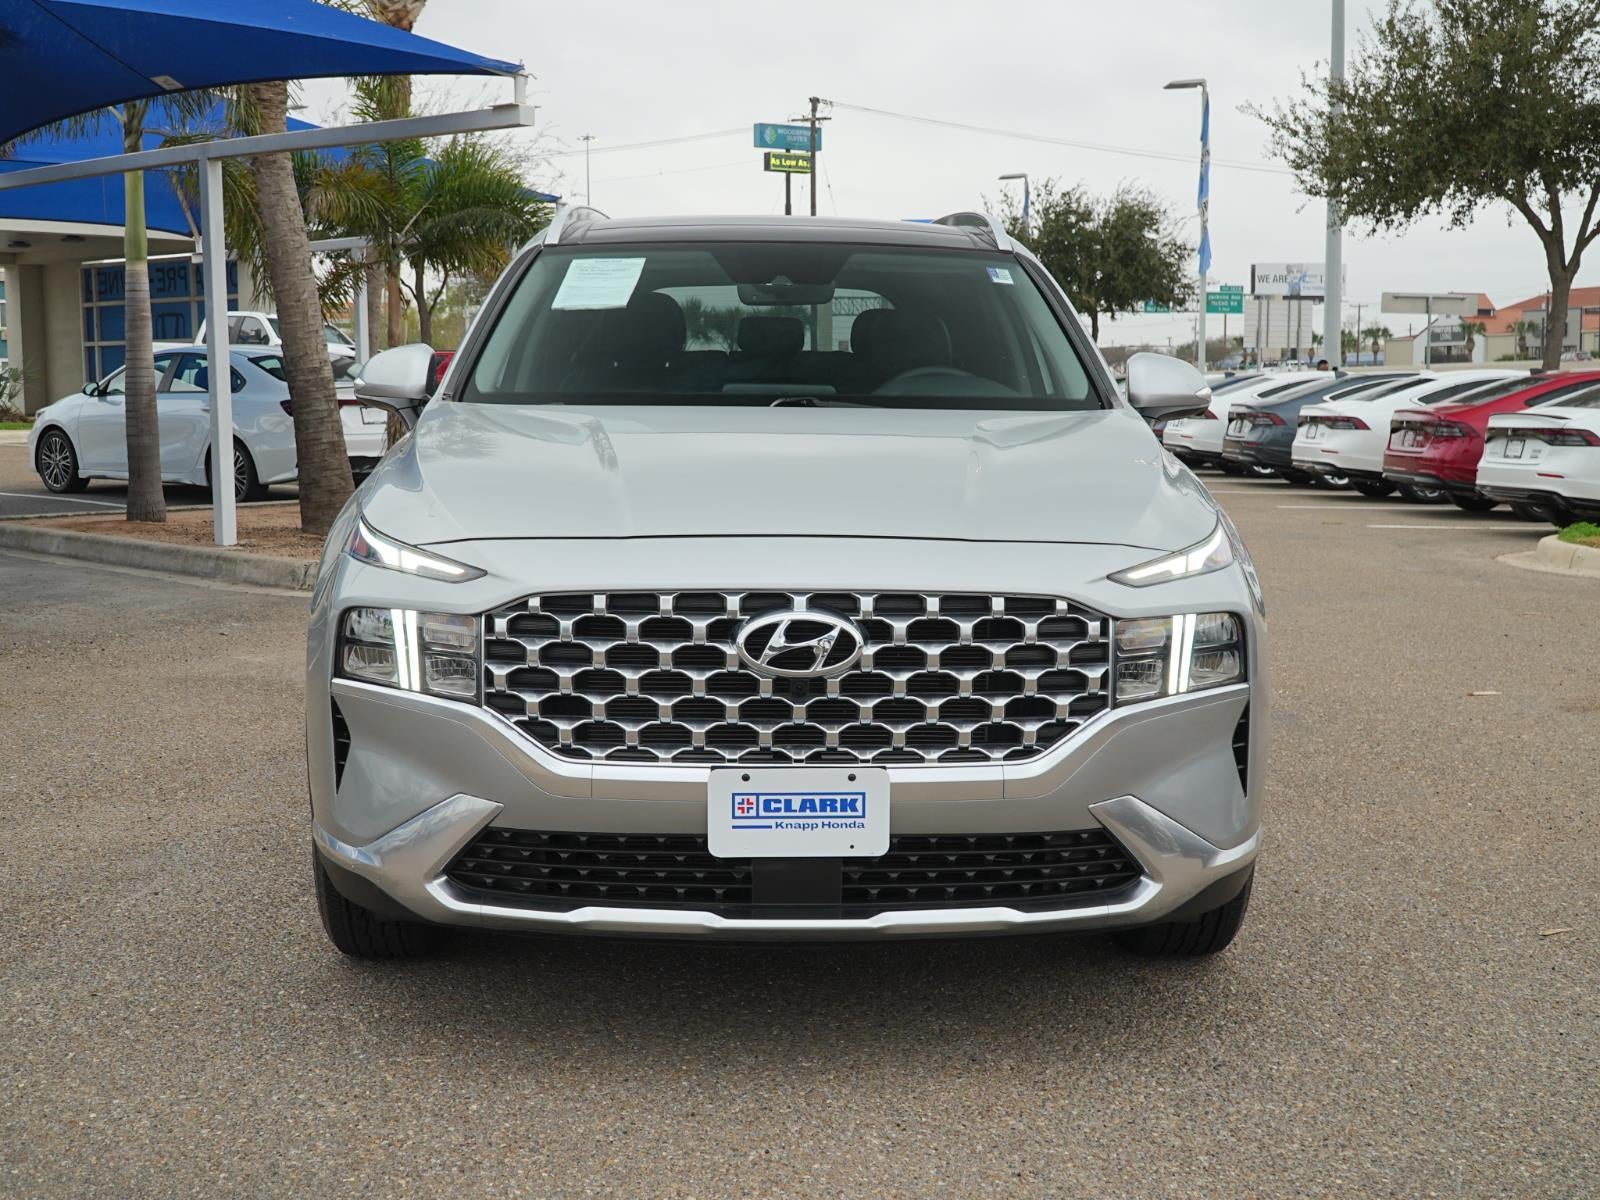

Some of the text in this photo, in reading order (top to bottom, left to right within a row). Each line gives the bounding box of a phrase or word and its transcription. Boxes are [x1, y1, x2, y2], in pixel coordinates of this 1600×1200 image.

[1257, 274, 1271, 284] WE
[763, 798, 859, 813] CLARK
[775, 821, 865, 831] Knapp Honda
